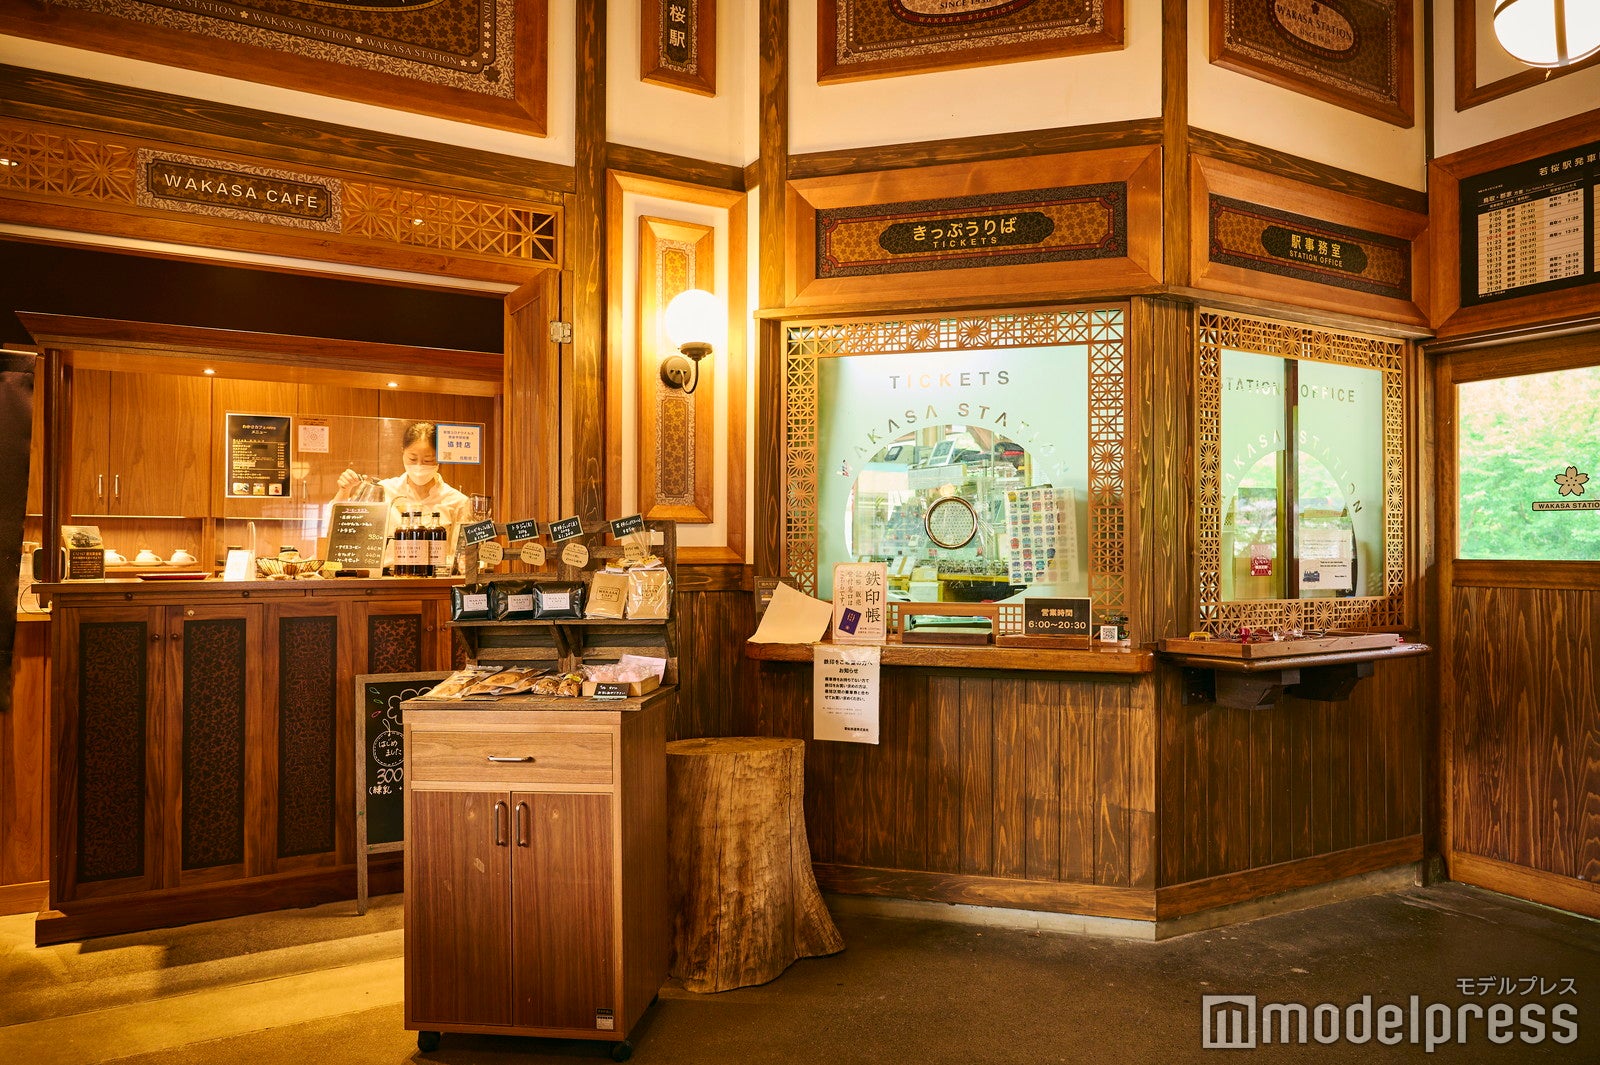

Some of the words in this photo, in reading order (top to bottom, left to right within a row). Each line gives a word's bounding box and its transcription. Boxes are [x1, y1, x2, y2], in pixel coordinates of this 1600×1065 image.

[918, 15, 961, 24] WAKASA
[968, 4, 1015, 21] STATION
[1276, 4, 1313, 26] WAKASA
[1316, 19, 1351, 40] STATION
[669, 4, 686, 48] 桜駅
[252, 13, 302, 31] WAKASA
[305, 25, 352, 42] STATION
[366, 38, 413, 56] WAKASA
[415, 48, 457, 65] STATION
[1539, 153, 1600, 176] 若桜駅発車
[164, 173, 257, 199] WAKASA
[266, 190, 318, 208] CAFE
[913, 217, 1018, 241] きっぷうりば
[933, 236, 998, 249] TICKETS
[1291, 233, 1341, 259] 駅事務室
[1289, 249, 1318, 262] STATION
[1319, 256, 1343, 268] OFFICE
[889, 370, 1009, 389] TICKETS
[1221, 376, 1281, 397] TATION
[1301, 384, 1355, 403] OFFICE
[447, 441, 471, 449] 協賛店
[865, 570, 881, 623] 鉄印帳
[1040, 608, 1073, 617] 営業時間
[378, 738, 398, 748] はじめ
[377, 767, 404, 785] 300
